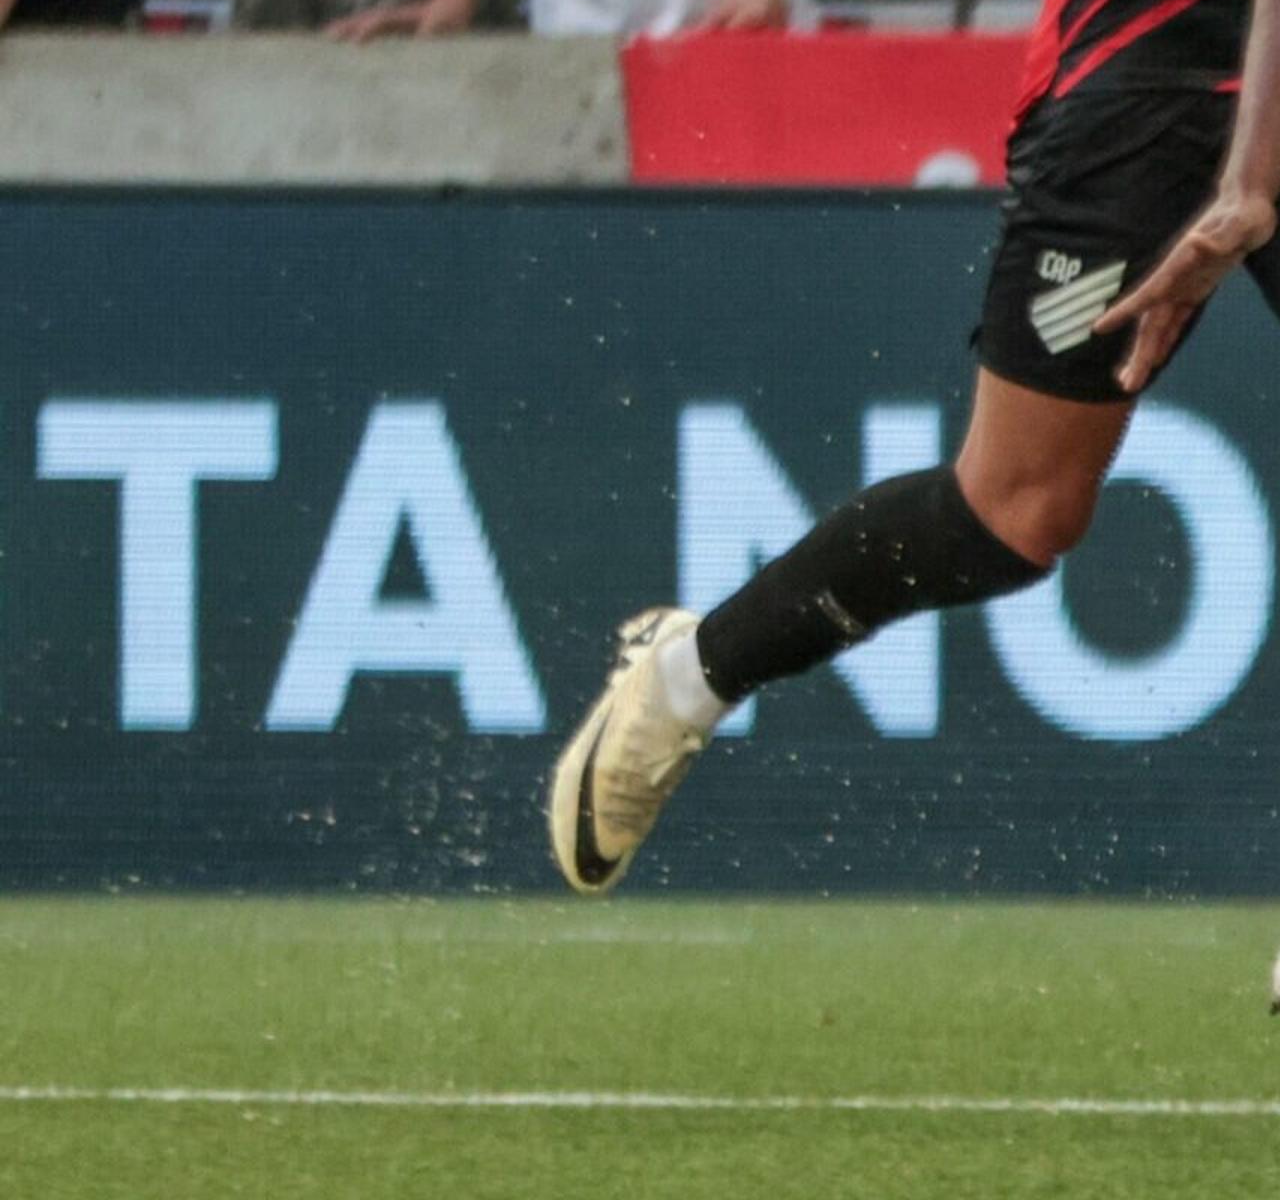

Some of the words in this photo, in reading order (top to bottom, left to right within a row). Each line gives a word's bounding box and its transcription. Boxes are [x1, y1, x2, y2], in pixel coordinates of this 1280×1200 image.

[1040, 250, 1082, 286] CAP
[35, 398, 547, 734] TA
[676, 398, 1276, 744] NO
